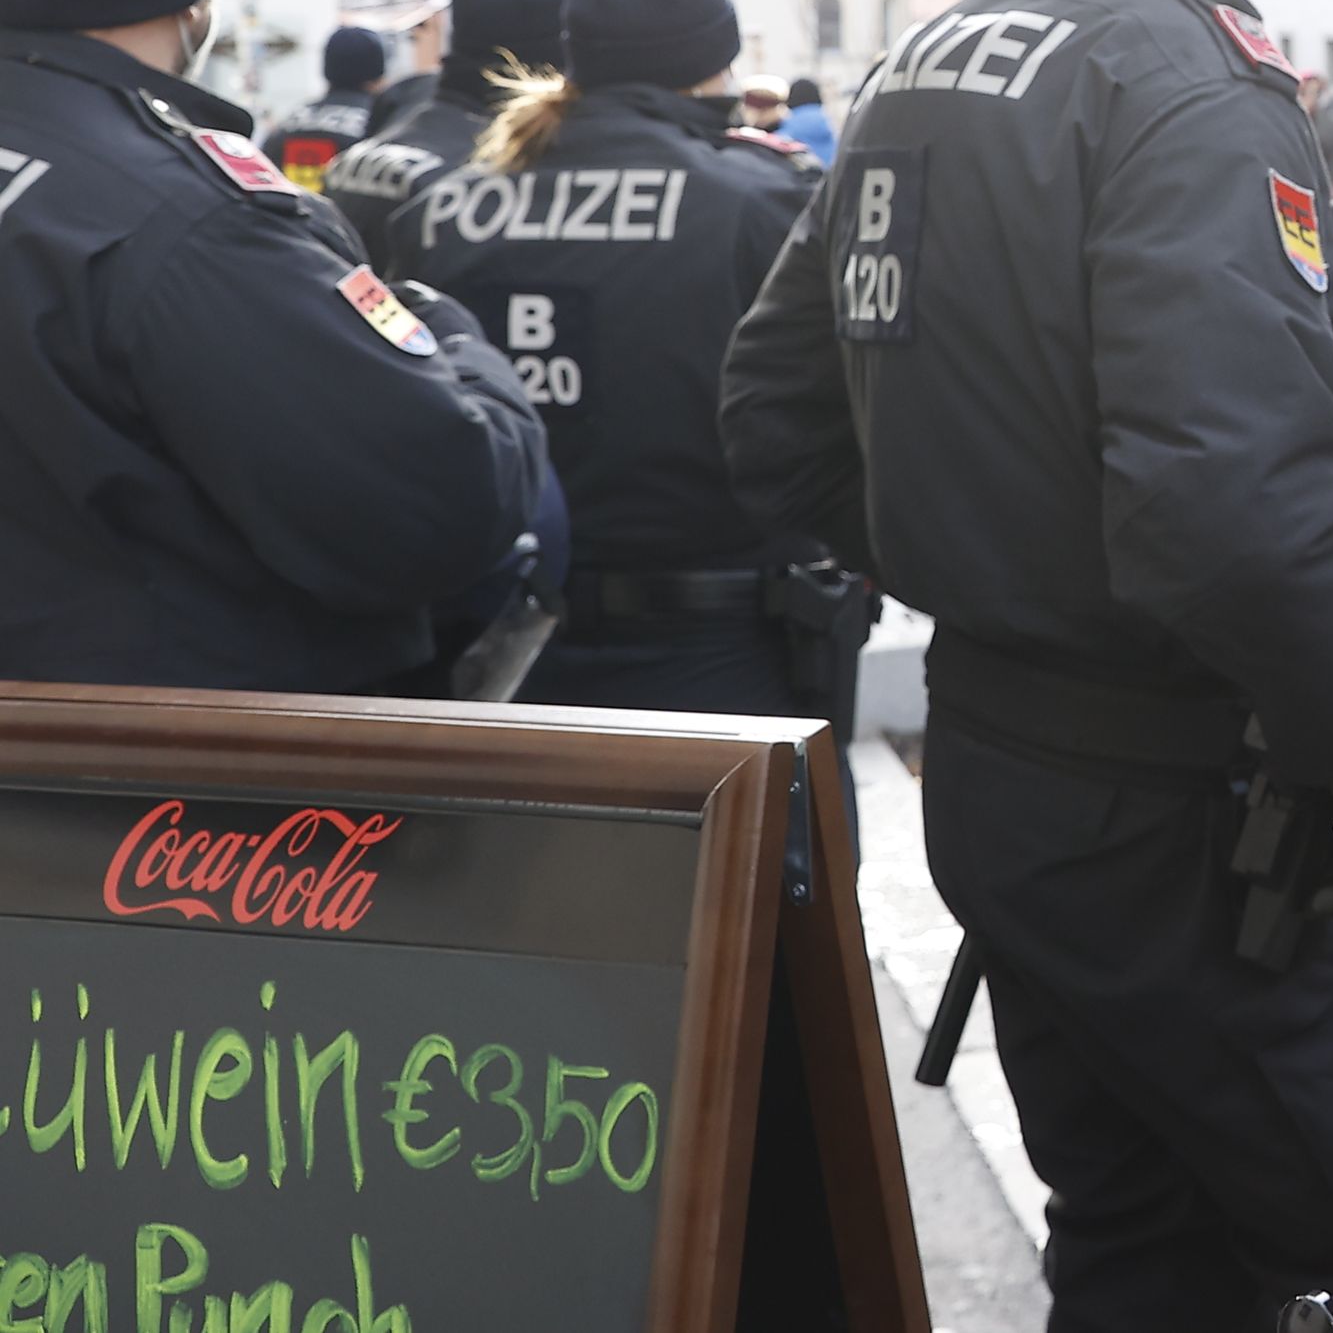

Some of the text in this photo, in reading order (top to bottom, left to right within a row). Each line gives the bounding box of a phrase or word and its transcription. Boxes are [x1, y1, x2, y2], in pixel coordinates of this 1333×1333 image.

[850, 9, 1078, 115] LIZEI
[420, 168, 688, 250] POLIZEI
[857, 168, 896, 243] B
[507, 292, 557, 351] B
[842, 253, 902, 323] 120
[512, 354, 582, 407] 20
[103, 799, 403, 932] Coca-Cola
[0, 980, 365, 1194] üwein
